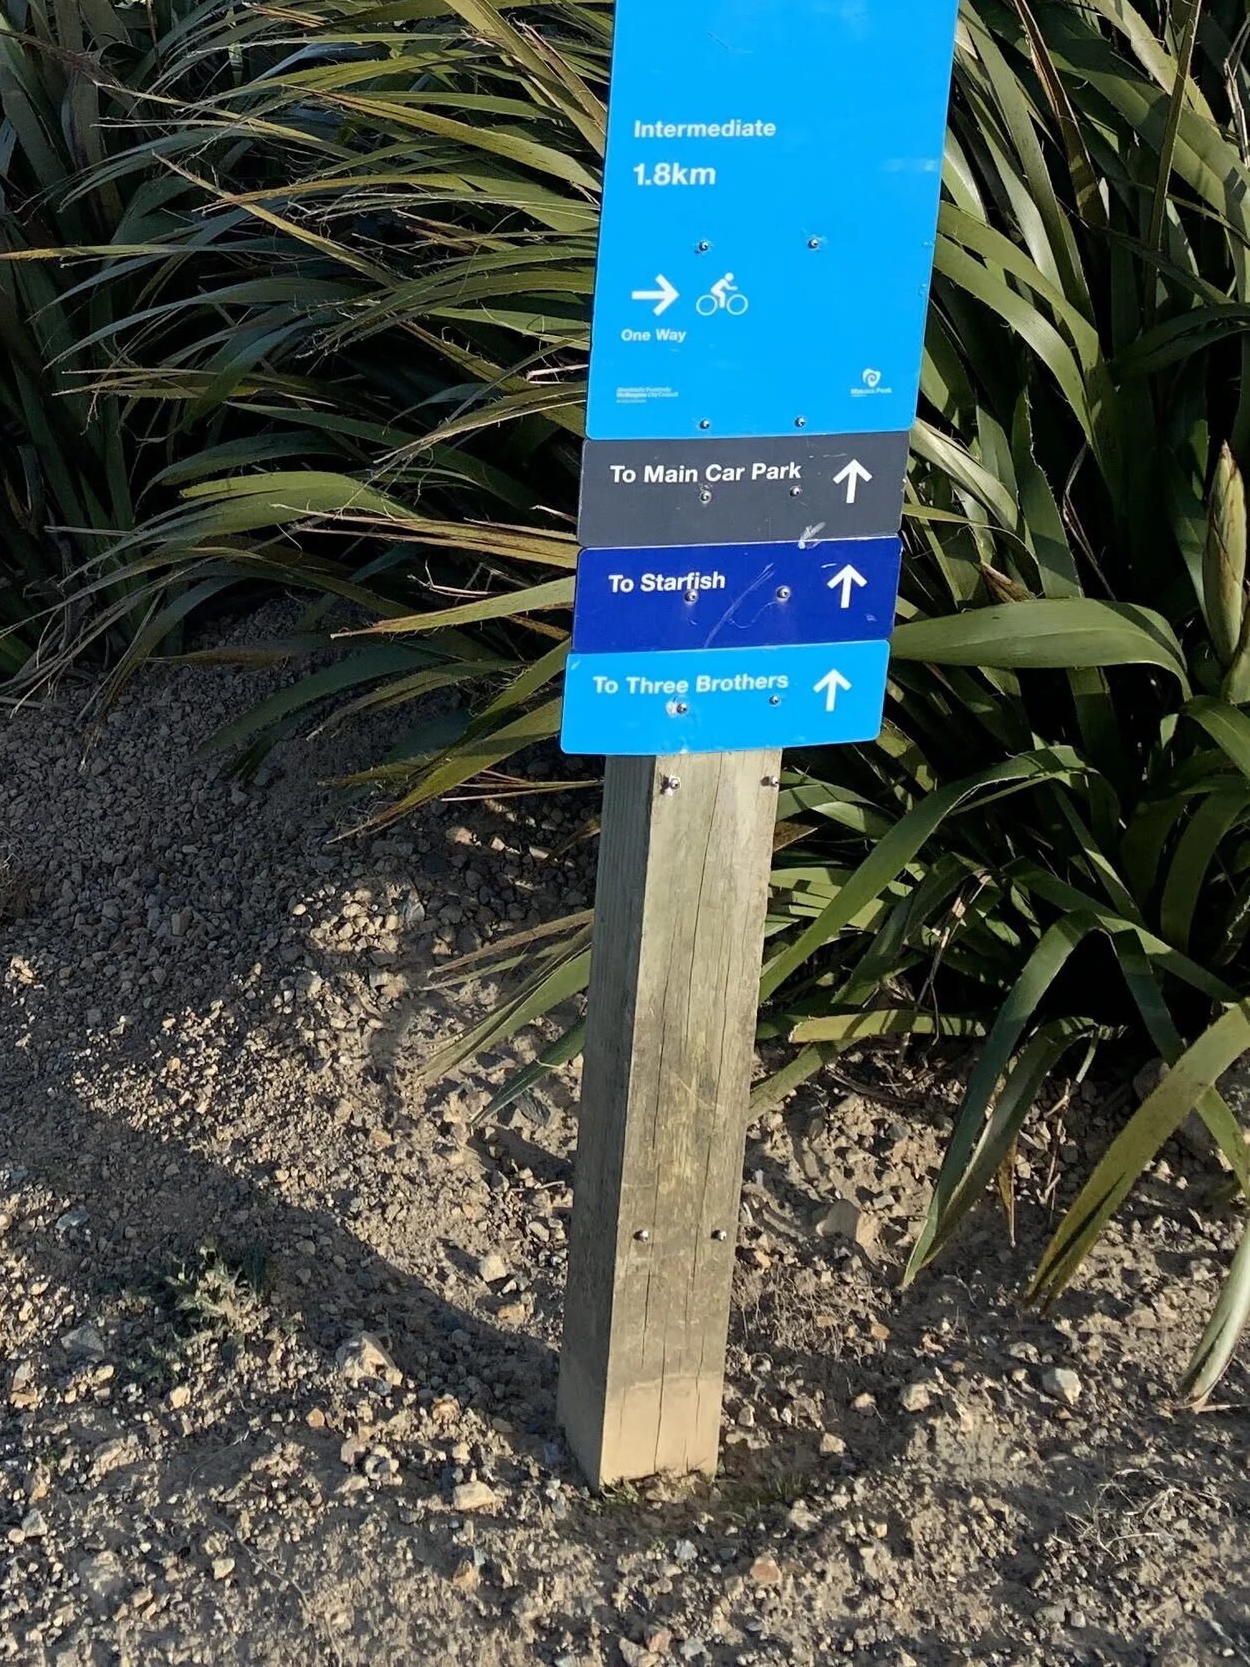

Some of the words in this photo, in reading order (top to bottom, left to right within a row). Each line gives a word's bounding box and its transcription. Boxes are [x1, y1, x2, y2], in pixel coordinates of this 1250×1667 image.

[634, 119, 776, 138] Intermediate
[633, 163, 716, 186] 1.8km
[621, 329, 651, 342] One
[655, 329, 686, 343] Way
[611, 465, 636, 483] To
[643, 465, 699, 483] Main
[705, 464, 745, 482] Car
[751, 461, 802, 480] Park
[608, 574, 634, 593] To
[640, 571, 726, 592] Starfish
[593, 675, 619, 694] To
[626, 676, 689, 694] Three
[695, 673, 789, 692] Brothers
